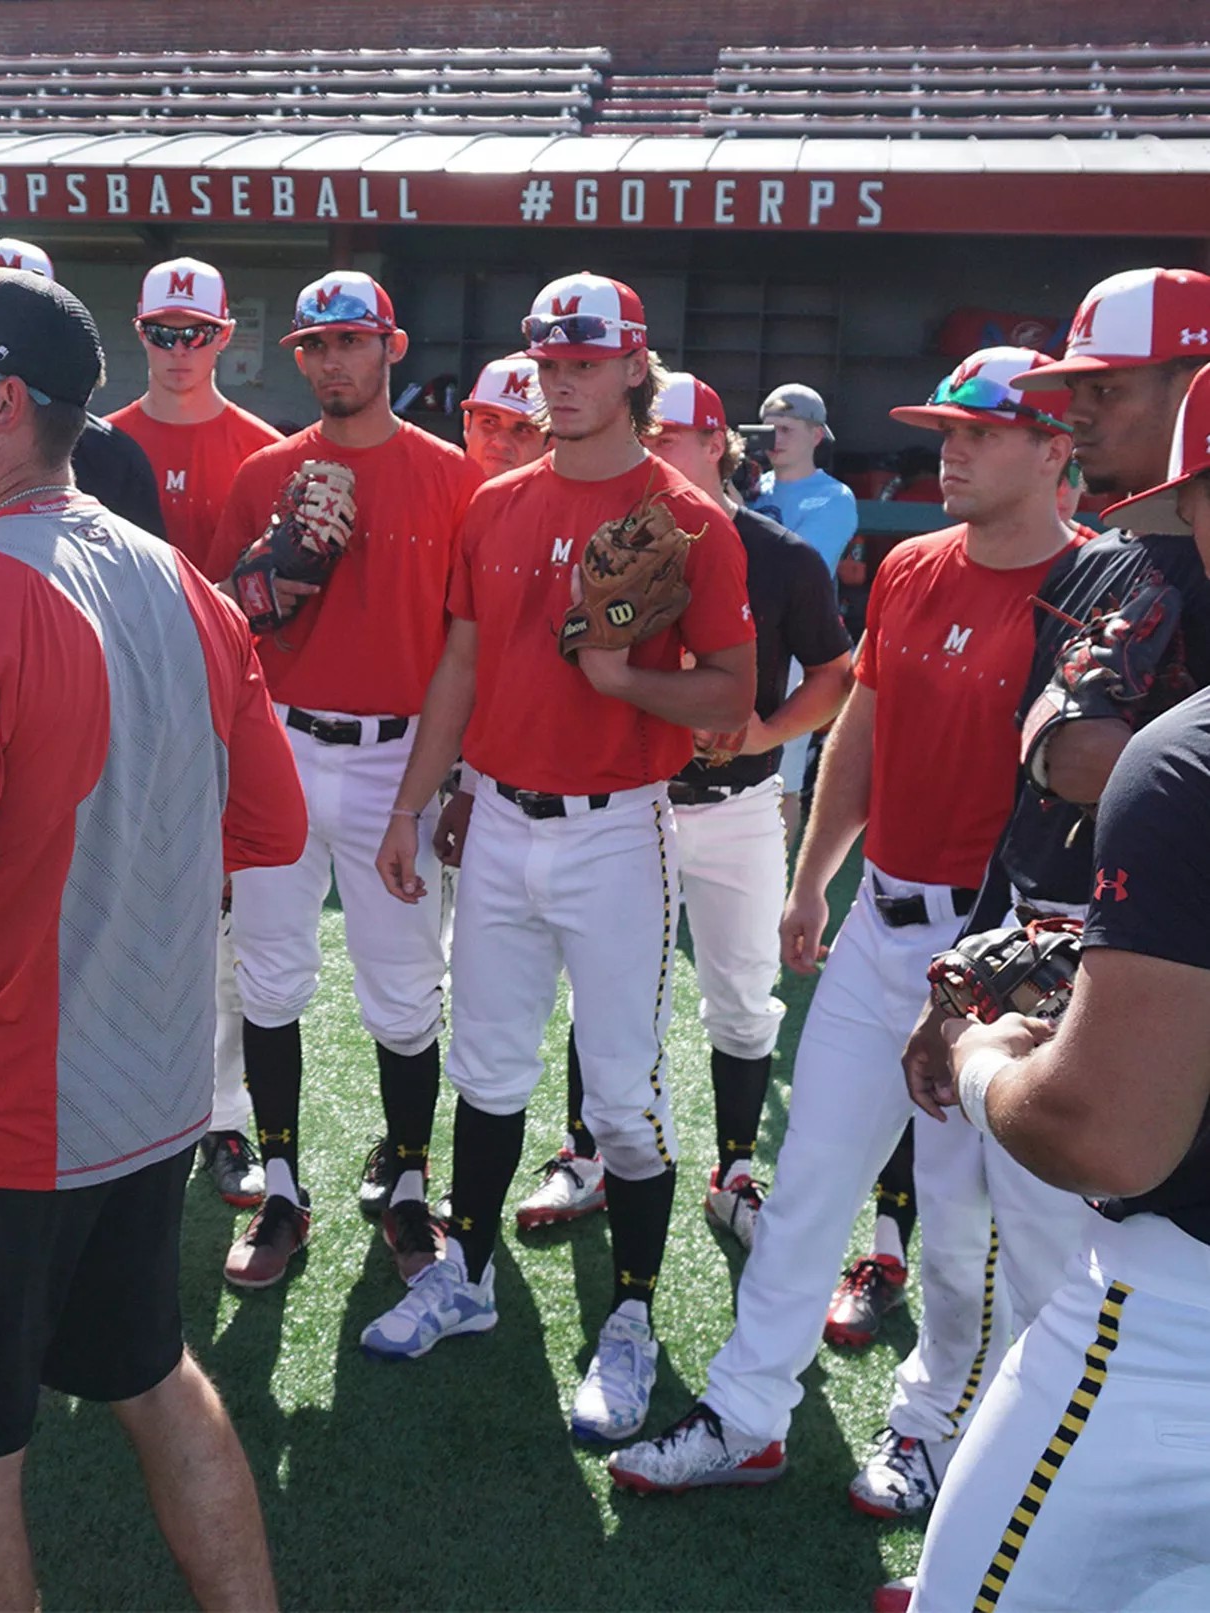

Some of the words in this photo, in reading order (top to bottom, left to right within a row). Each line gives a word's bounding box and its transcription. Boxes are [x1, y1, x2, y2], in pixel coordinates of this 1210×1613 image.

[519, 178, 884, 226] #GOTERPS
[167, 271, 196, 297] M
[502, 370, 532, 400] M
[166, 469, 186, 491] M
[551, 537, 574, 563] M
[607, 602, 634, 625] W
[943, 623, 973, 654] M
